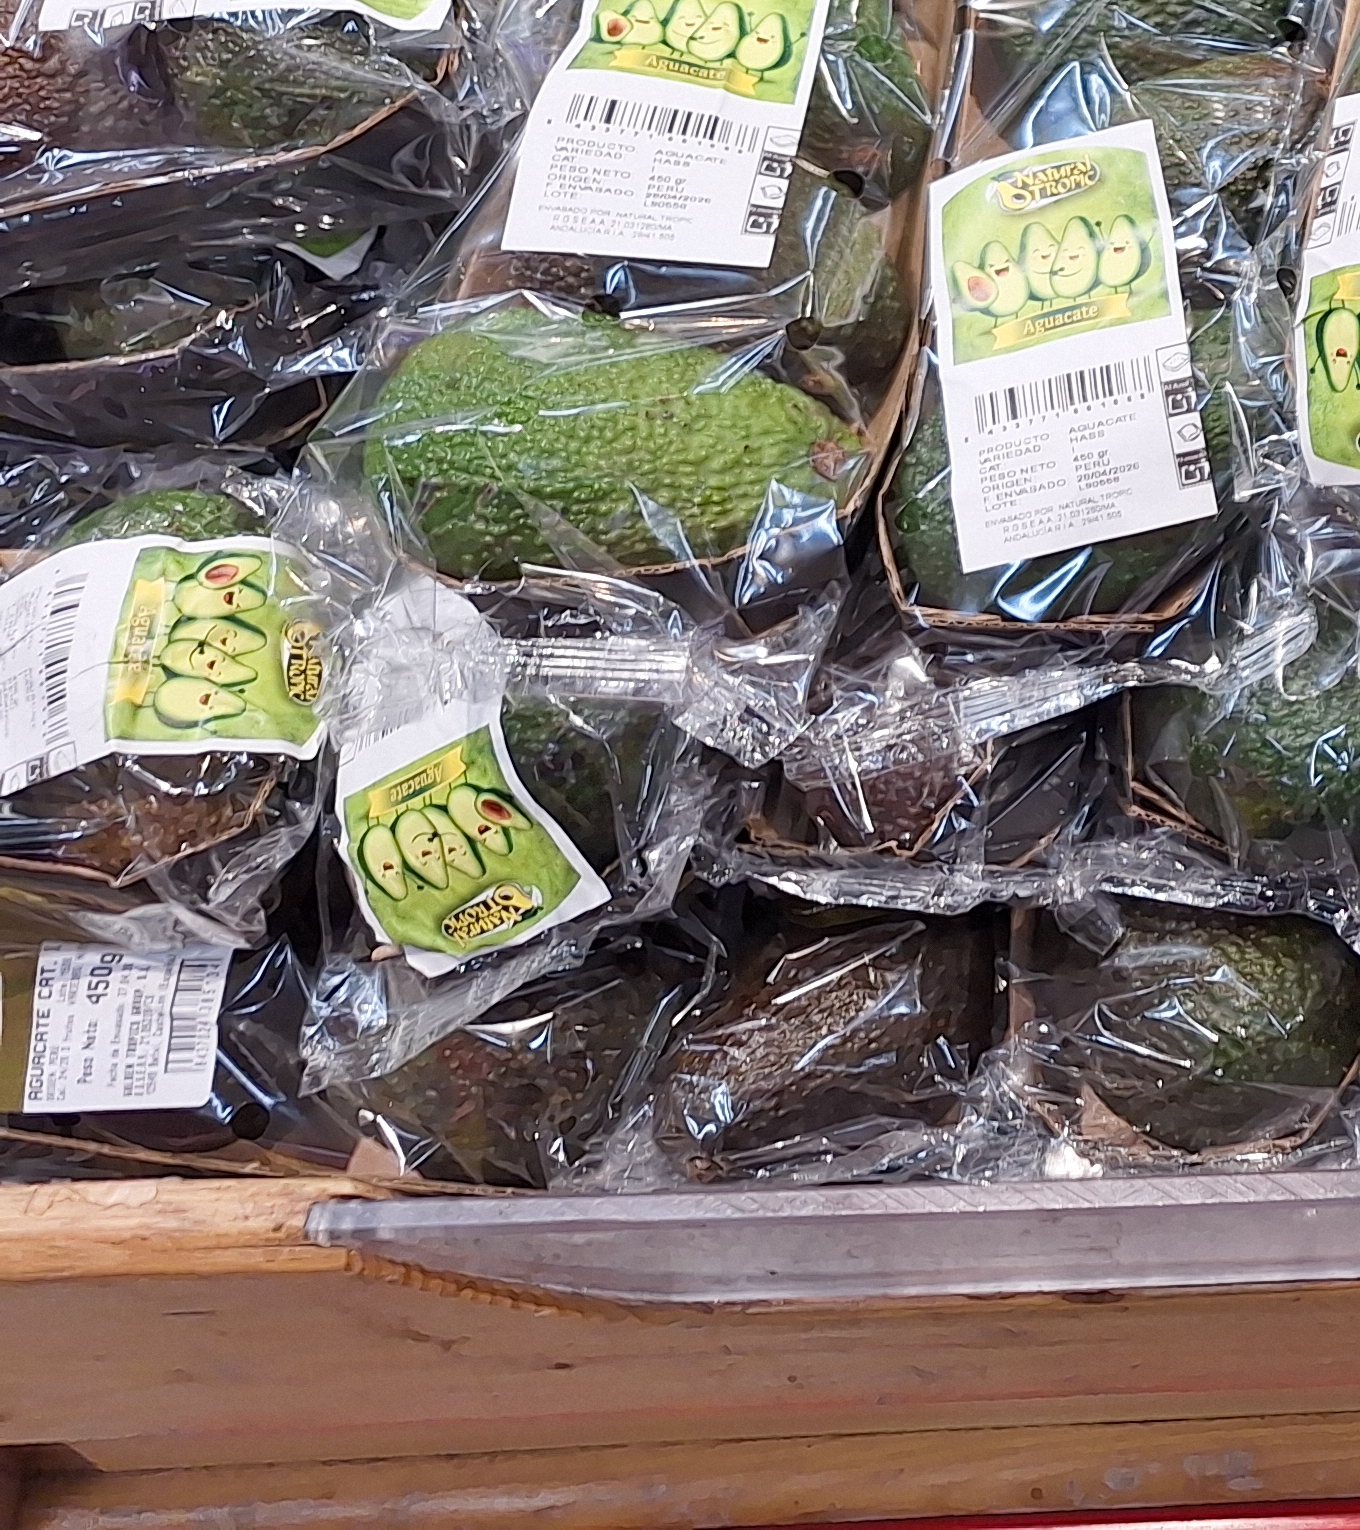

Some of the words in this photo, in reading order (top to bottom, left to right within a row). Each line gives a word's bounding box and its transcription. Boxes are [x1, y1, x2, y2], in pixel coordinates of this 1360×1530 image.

[647, 54, 726, 80] Aguacate
[1015, 154, 1092, 189] Natural
[1030, 170, 1097, 202] TROPIC
[1023, 302, 1098, 338] Aguacate
[306, 647, 323, 700] atural
[390, 765, 443, 802] Aguacate
[444, 890, 502, 934] TROPIC
[452, 906, 522, 947] Natural
[37, 960, 58, 1000] CAT.
[90, 952, 124, 1005] 450g
[28, 1008, 51, 1101] AGUACATE
